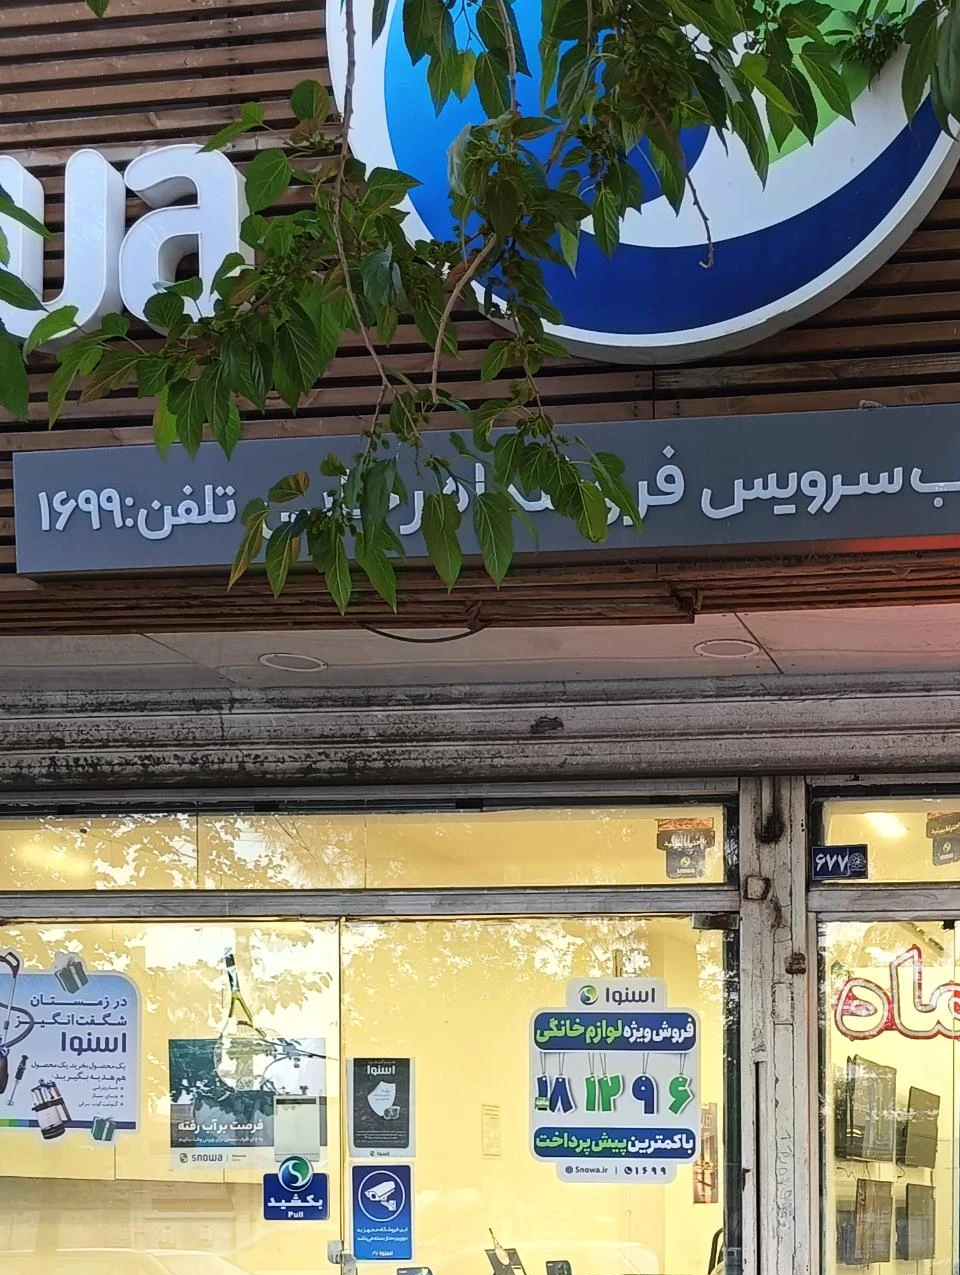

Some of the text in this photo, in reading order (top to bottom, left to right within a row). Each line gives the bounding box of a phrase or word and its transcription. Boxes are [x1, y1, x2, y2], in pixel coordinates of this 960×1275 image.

[700, 461, 903, 520] سرویس
[815, 854, 848, 872] ۶۷۷
[30, 994, 127, 1009] در زمستان
[605, 987, 655, 1006] اسنوا
[536, 1017, 694, 1044] فروش ویژه لوازم خانگی
[61, 1031, 127, 1056] اسنوا
[367, 1065, 396, 1076] اسنوا
[632, 1075, 655, 1114] ۹
[668, 1075, 693, 1115] ۶
[178, 1120, 200, 1134] رفته
[230, 1120, 264, 1134] فرصت
[536, 1132, 591, 1155] پرداخت
[592, 1132, 627, 1155] پیش
[192, 1153, 223, 1162] snowa
[575, 1166, 608, 1175] Snowa.ir
[268, 1194, 324, 1210] بکشید
